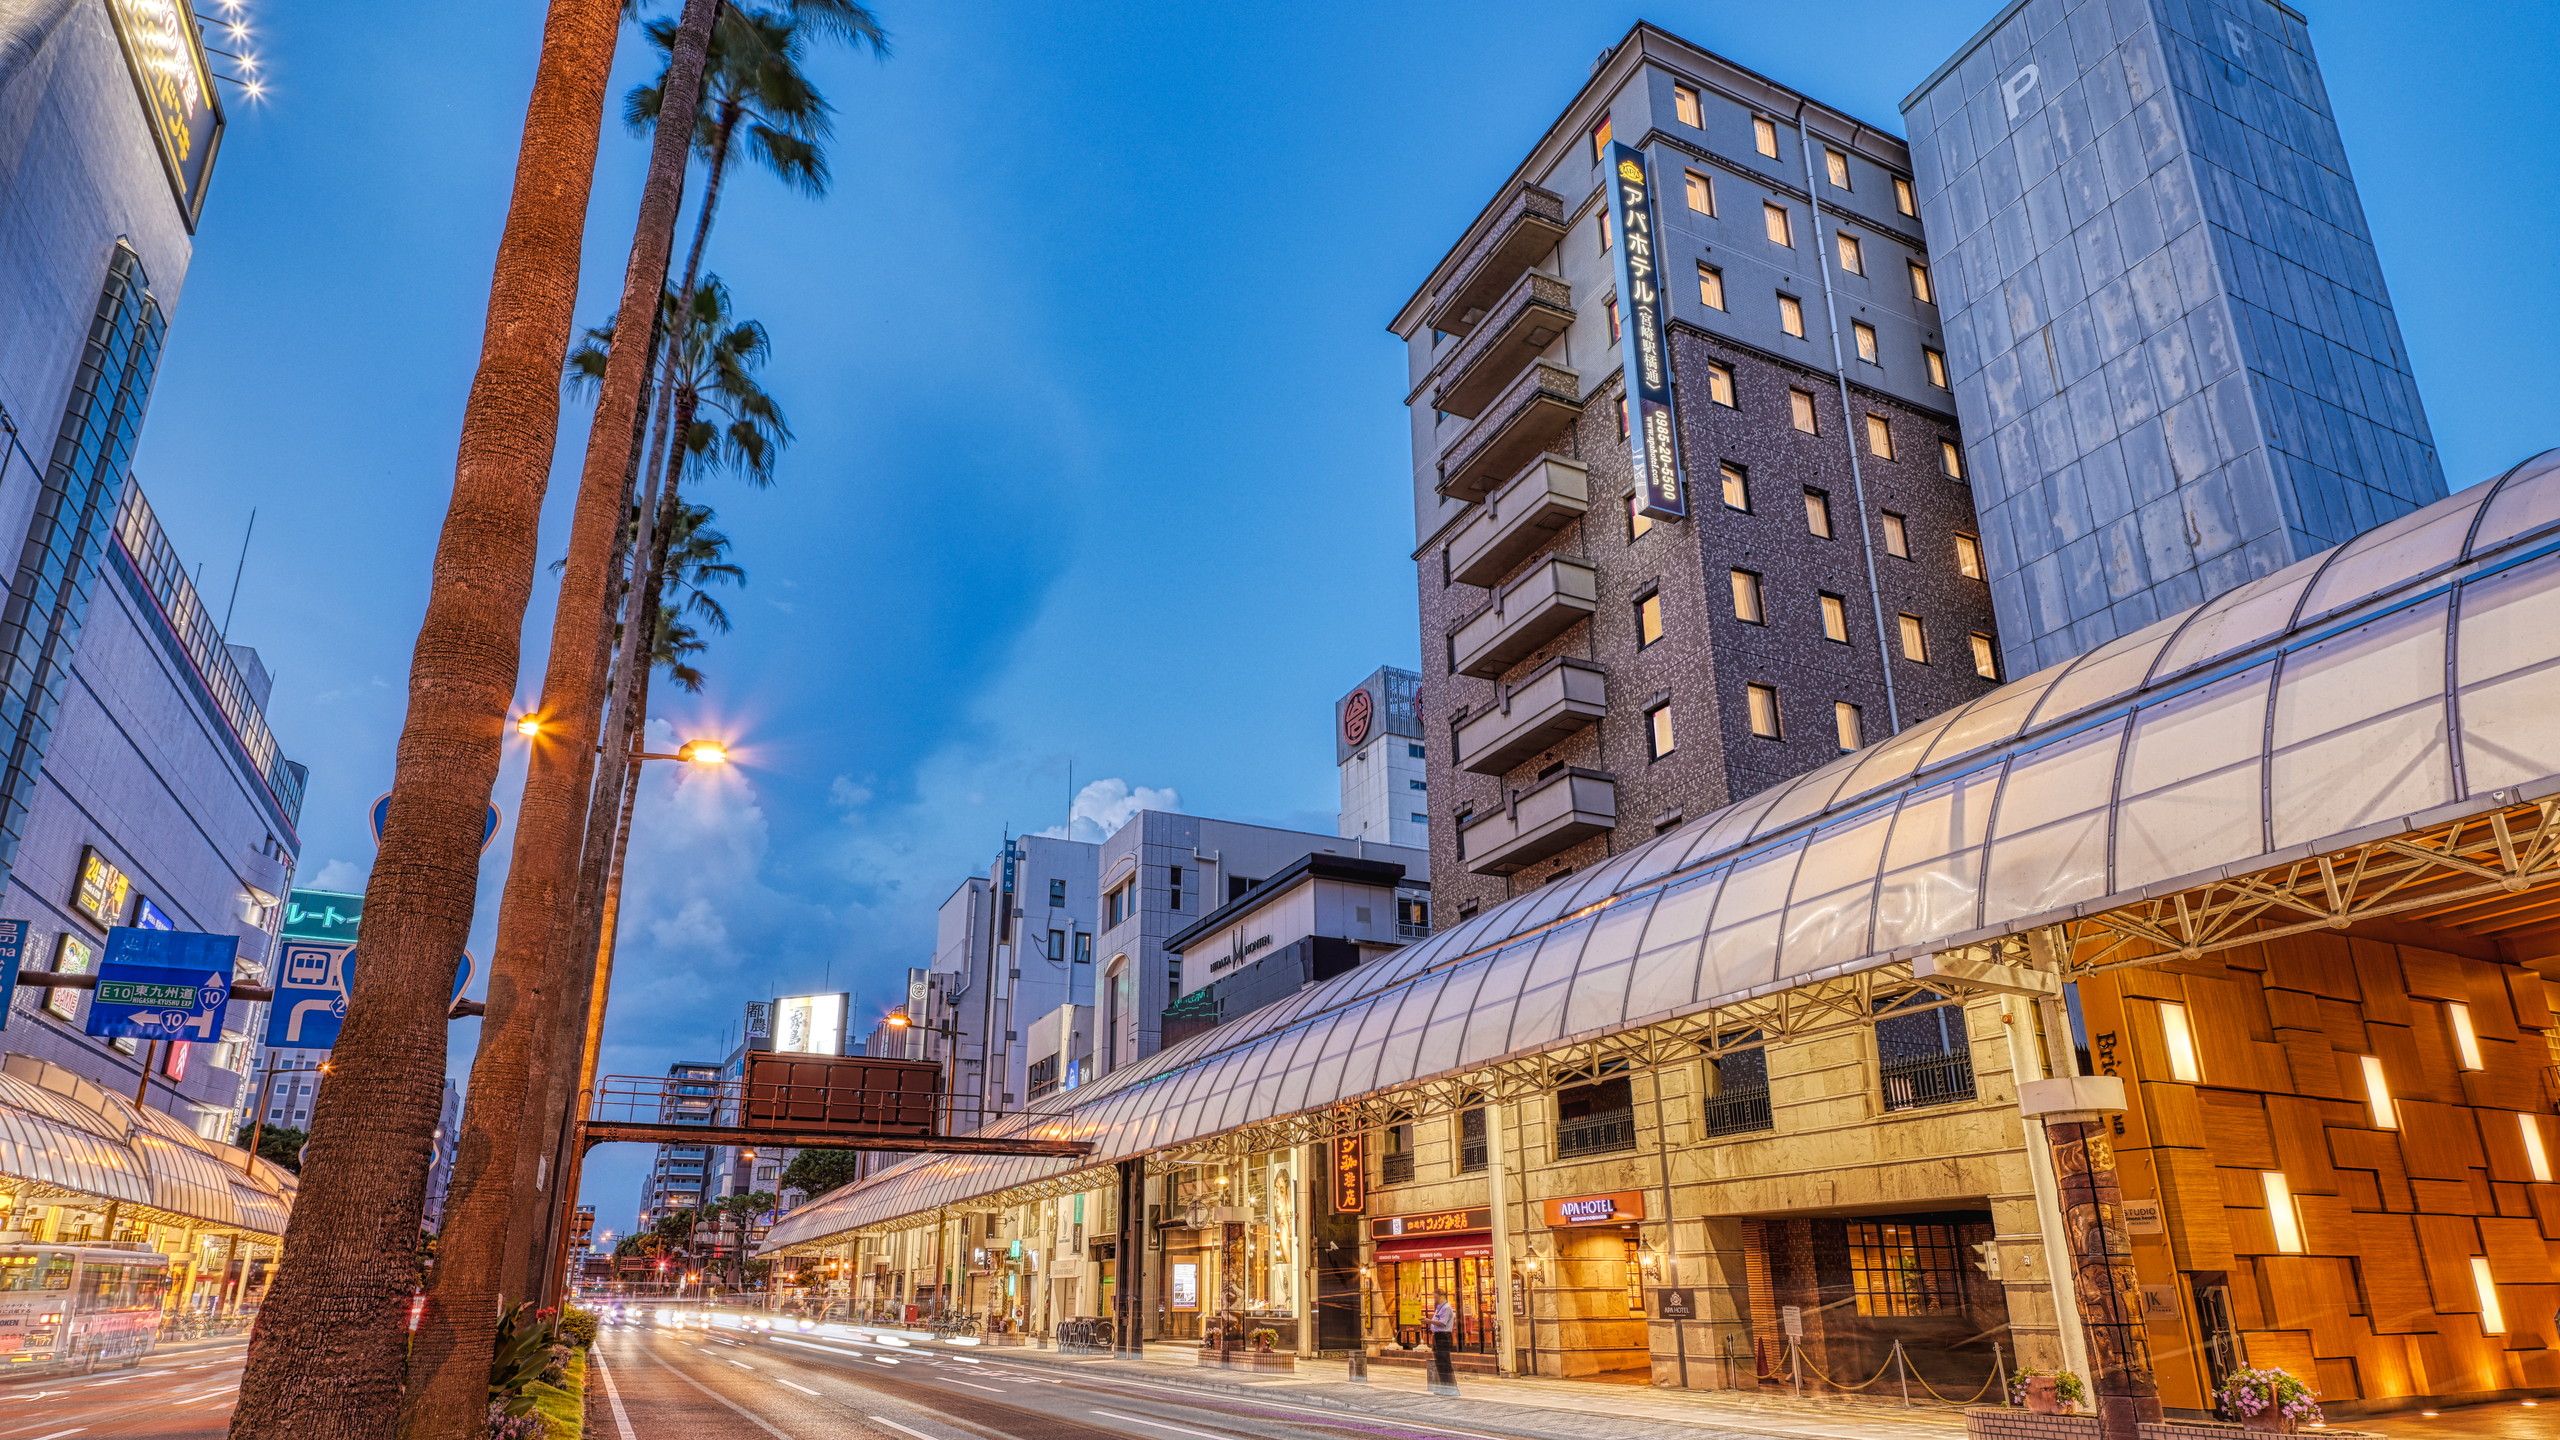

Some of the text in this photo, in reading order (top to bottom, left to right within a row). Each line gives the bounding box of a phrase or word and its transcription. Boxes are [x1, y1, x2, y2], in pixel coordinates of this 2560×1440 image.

[2225, 19, 2251, 57] P
[2001, 63, 2039, 121] P
[1648, 416, 1660, 485] www.apahotel.com
[1655, 410, 1676, 500] 0985-20-5500
[1245, 934, 1270, 955] HONTEN
[102, 986, 131, 998] E10
[134, 985, 194, 999] 東九州道
[204, 991, 220, 1004] 10
[132, 997, 179, 1006] HIGASHI-KYUSHU
[166, 1013, 182, 1026] 10
[1561, 1200, 1614, 1216] APA HOTEL
[2124, 1207, 2156, 1217] STUDIO
[2144, 1291, 2161, 1313] JK
[1674, 1306, 1690, 1314] HOTEL
